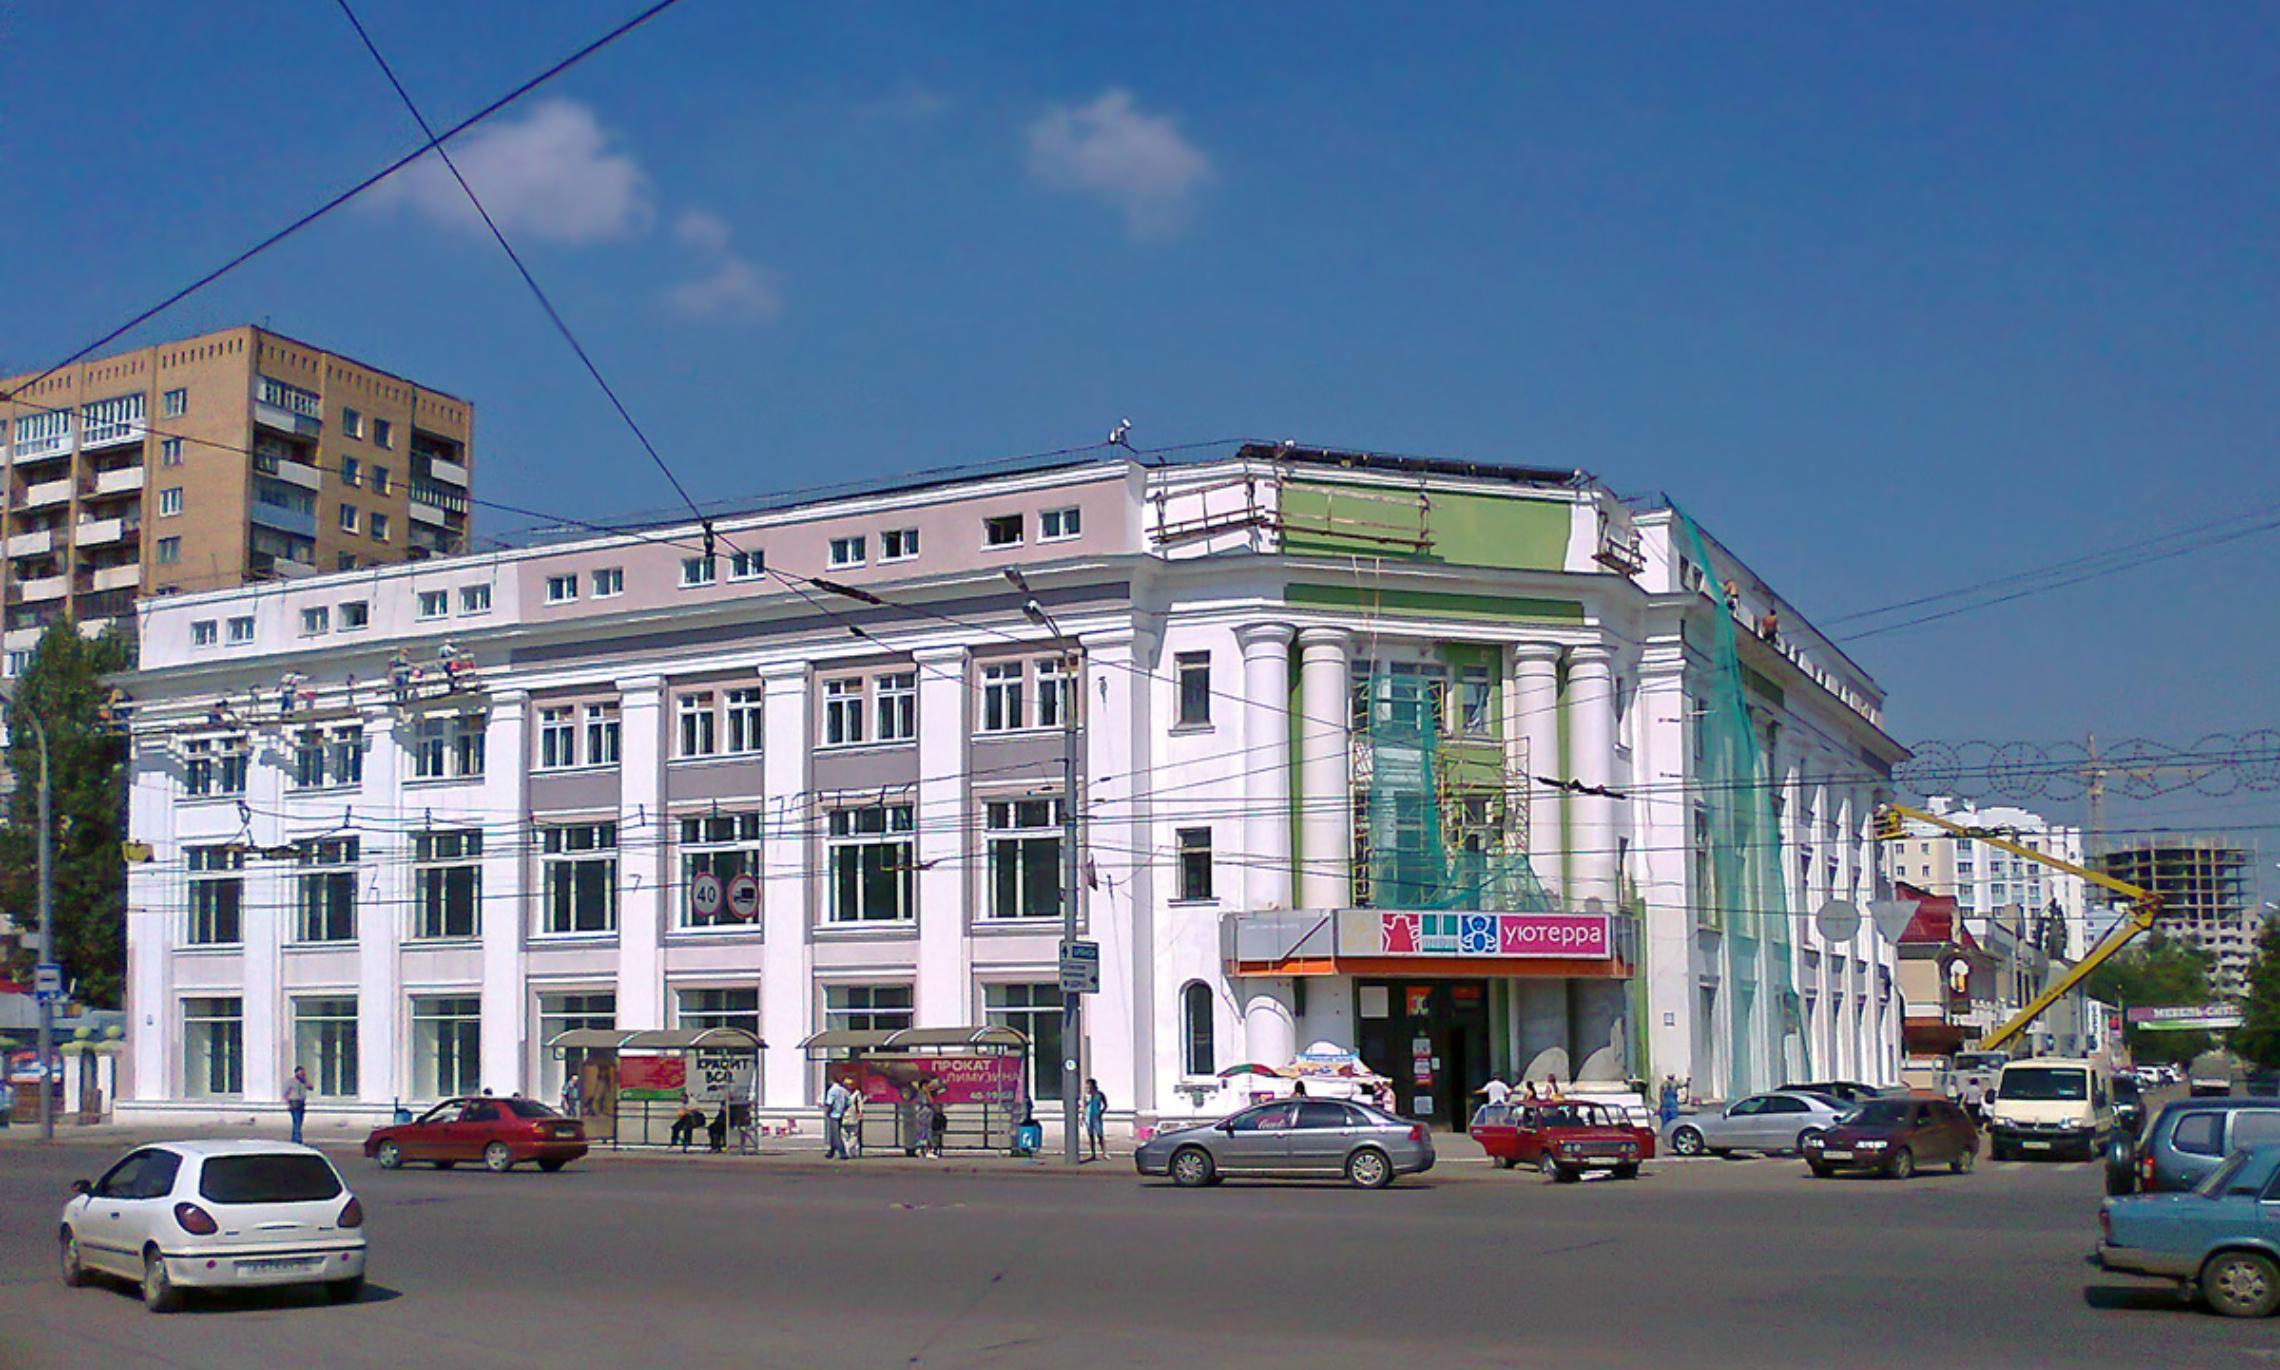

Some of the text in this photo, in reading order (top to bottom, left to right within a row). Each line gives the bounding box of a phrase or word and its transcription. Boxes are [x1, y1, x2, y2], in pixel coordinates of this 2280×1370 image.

[697, 885, 716, 904] 40
[1503, 924, 1601, 947] уютерра
[931, 1059, 993, 1072] ПРОКАТ
[943, 1071, 1019, 1084] ЛИМУЗИНА
